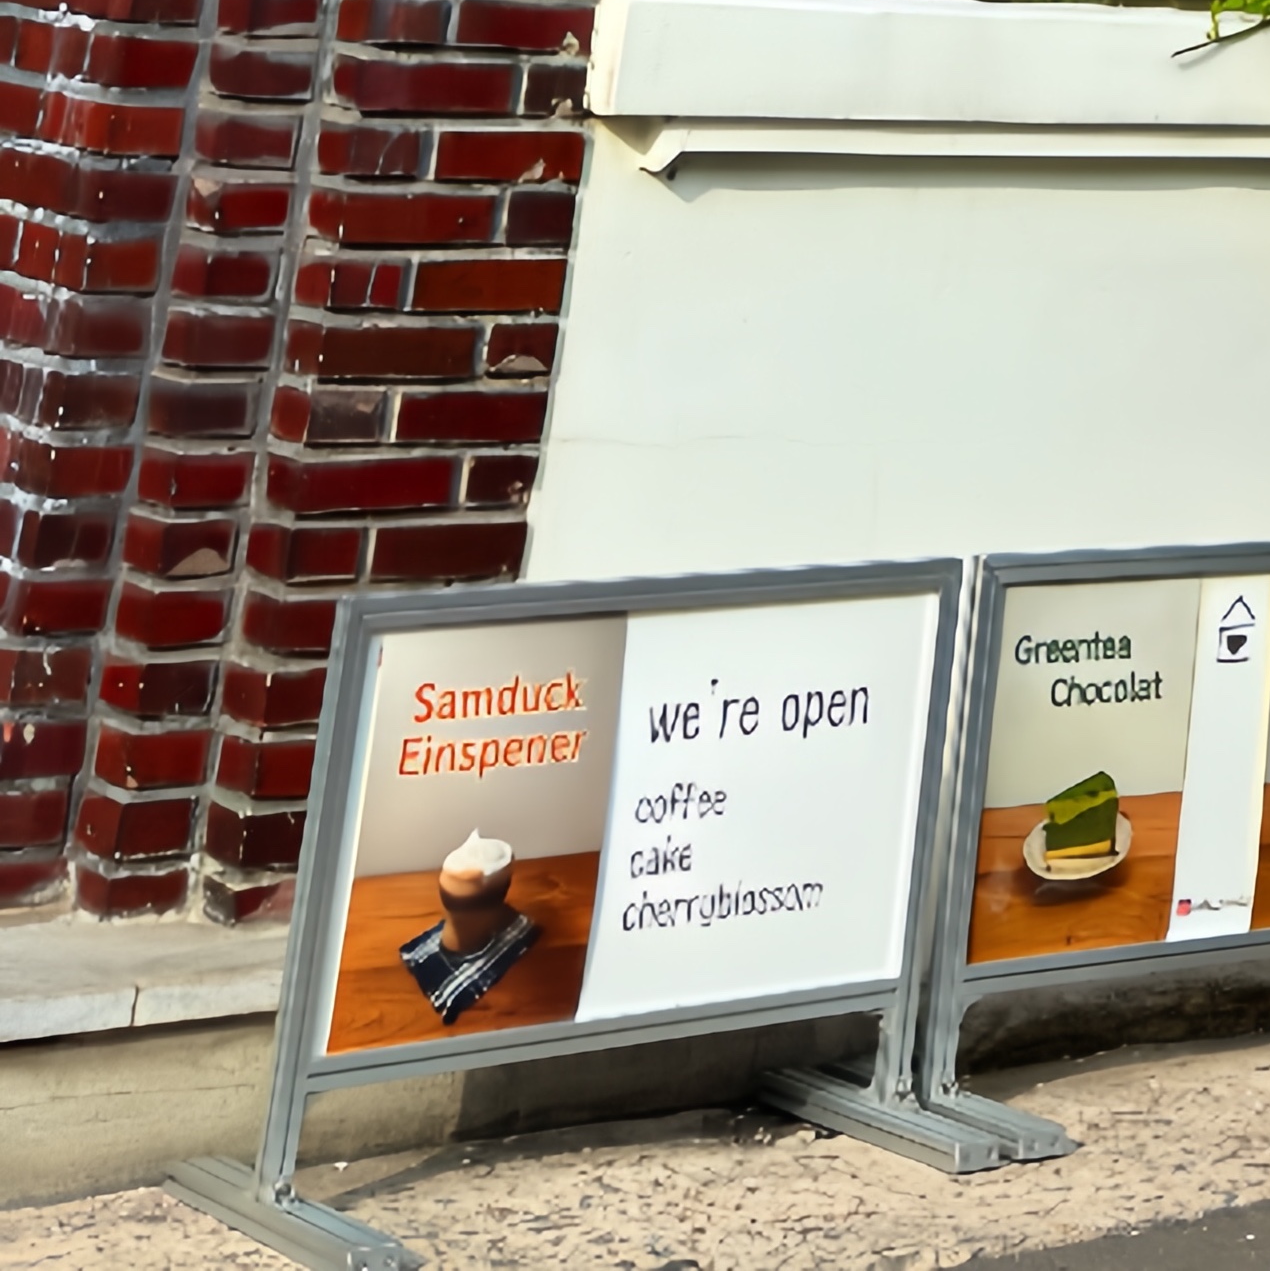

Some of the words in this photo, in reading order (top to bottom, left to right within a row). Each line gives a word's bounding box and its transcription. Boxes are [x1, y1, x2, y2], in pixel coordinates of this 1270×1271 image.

[1014, 630, 1132, 665] Greentea
[414, 671, 583, 723] Samduck
[649, 678, 760, 744] we're
[781, 686, 869, 740] open
[1050, 670, 1163, 707] Chocolat
[398, 731, 587, 779] Einspener
[634, 782, 728, 824] coffee
[630, 834, 692, 879] cake
